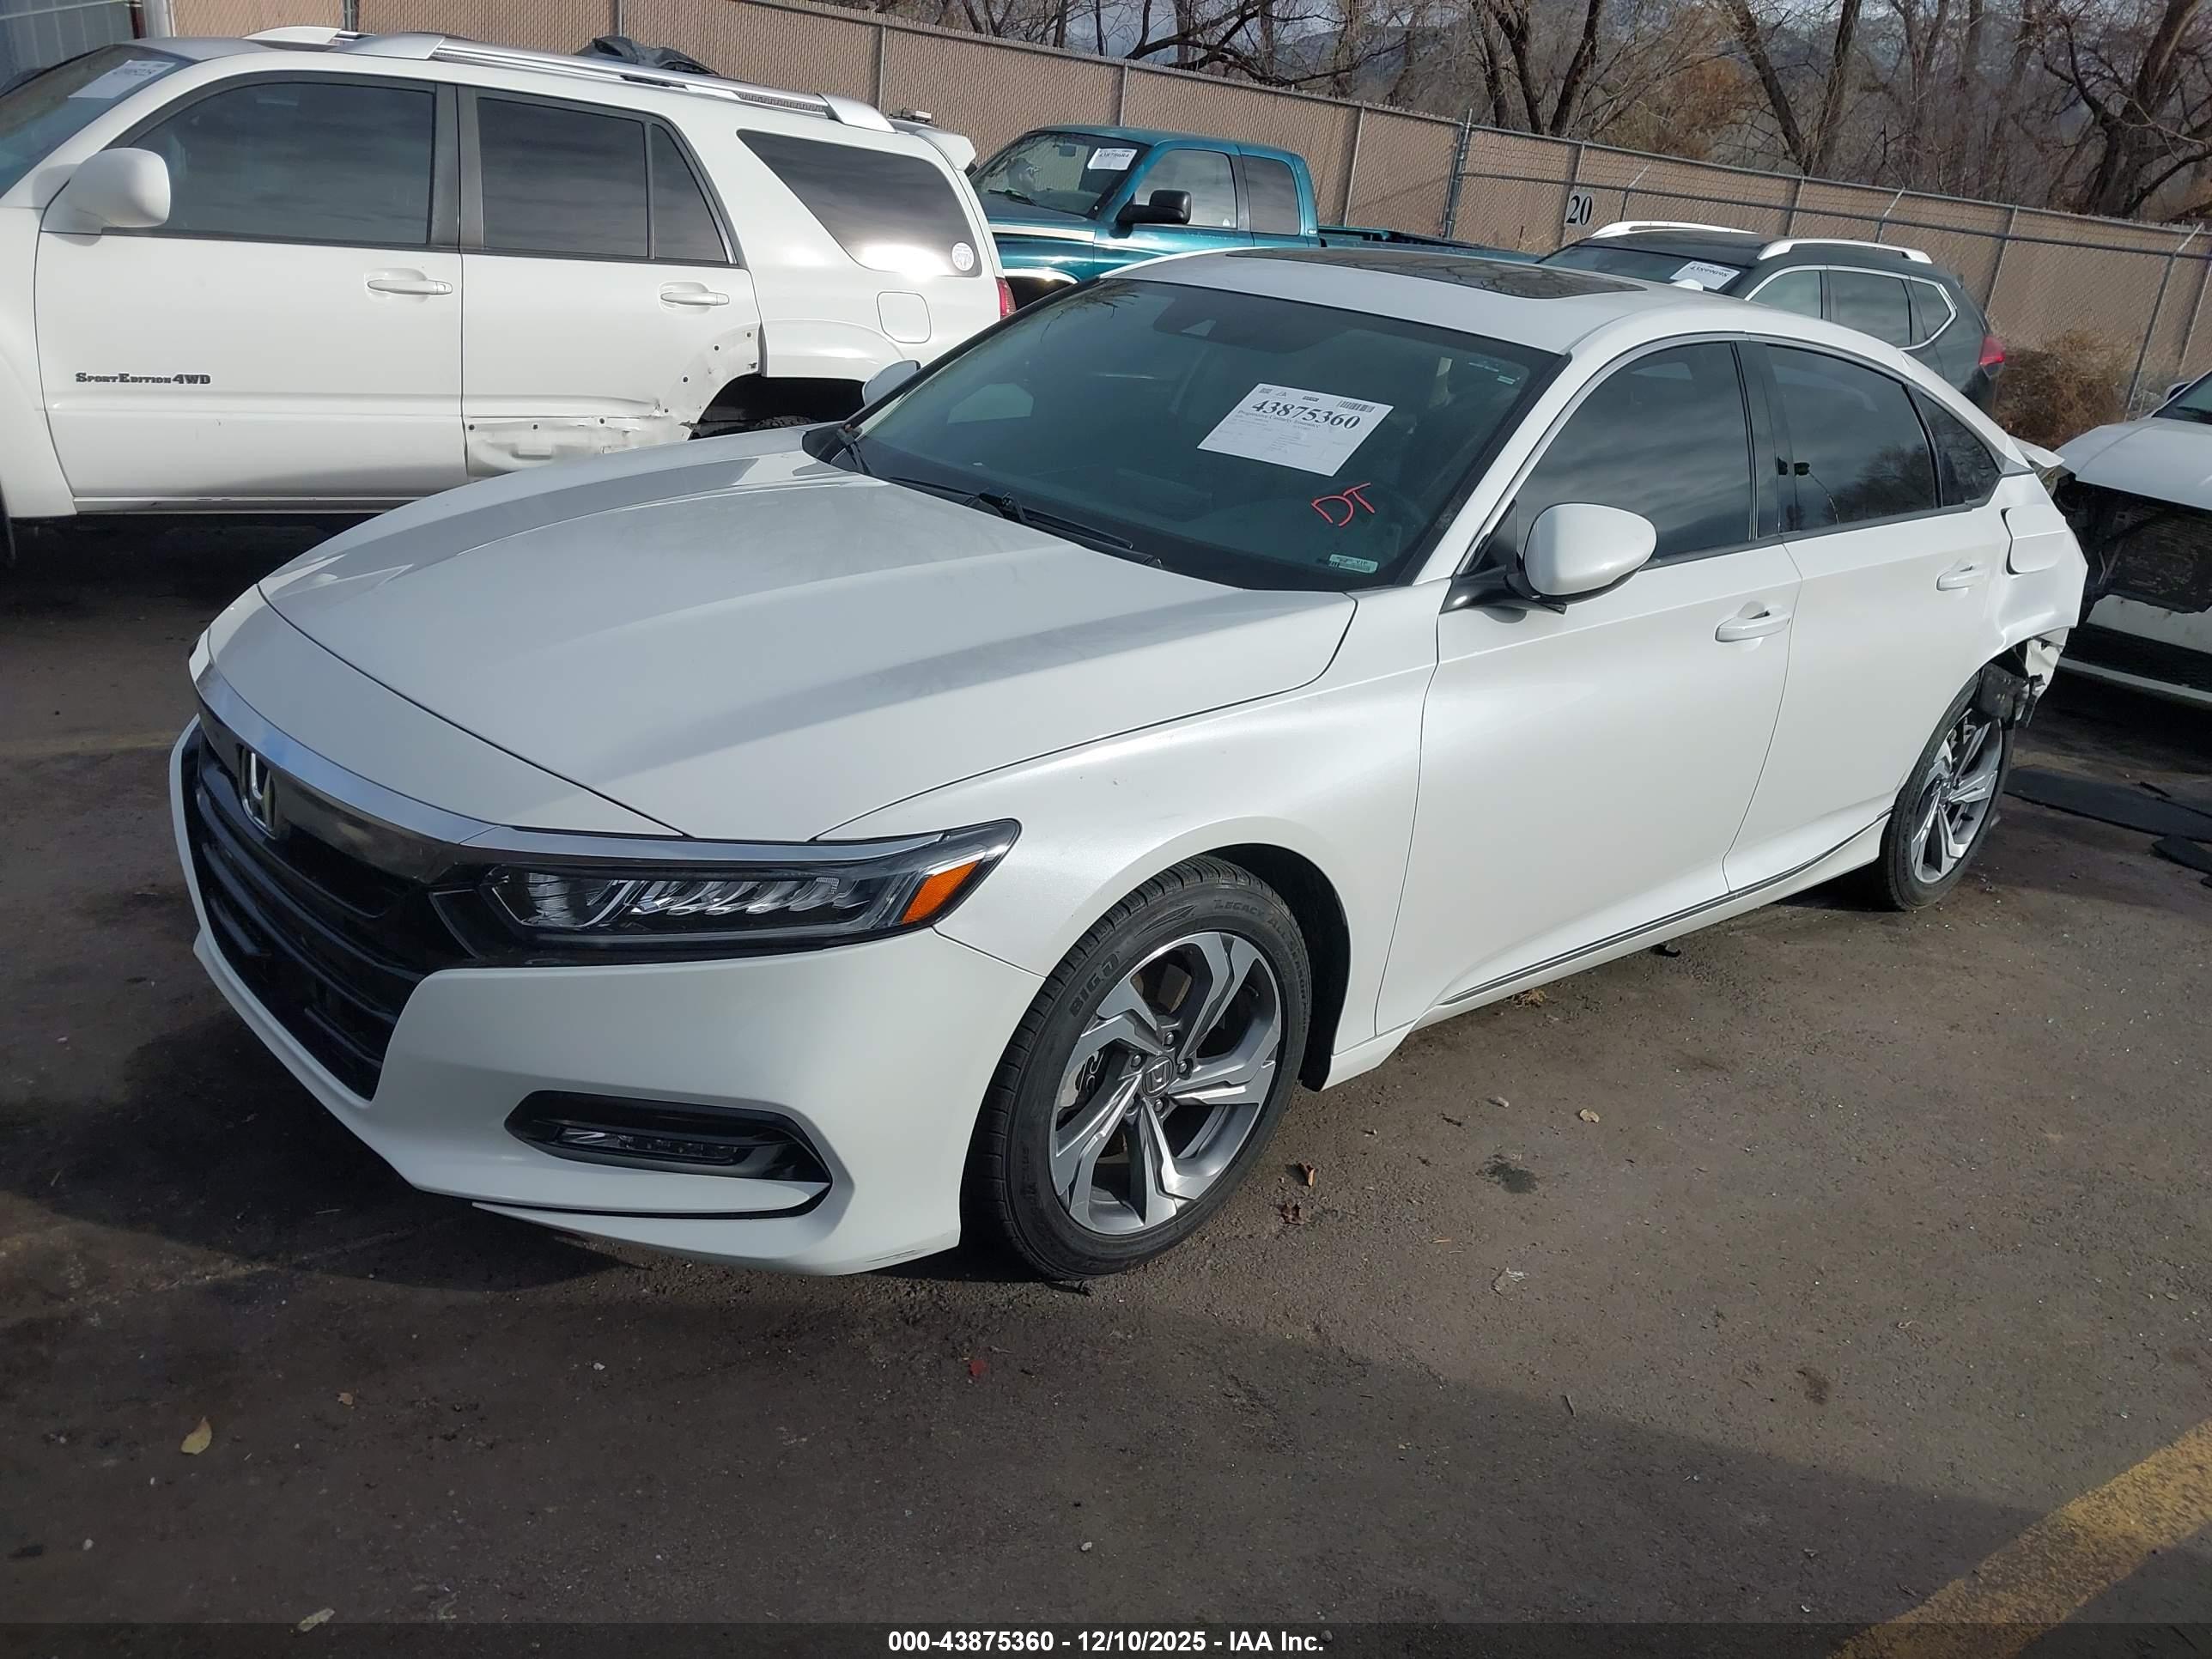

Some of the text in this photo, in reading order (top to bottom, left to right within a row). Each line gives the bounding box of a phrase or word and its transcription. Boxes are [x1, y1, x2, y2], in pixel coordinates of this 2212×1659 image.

[1565, 195, 1593, 226] 20
[1251, 399, 1361, 429] 43875360
[1311, 483, 1375, 526] DT
[1213, 899, 1265, 916] LEGACY
